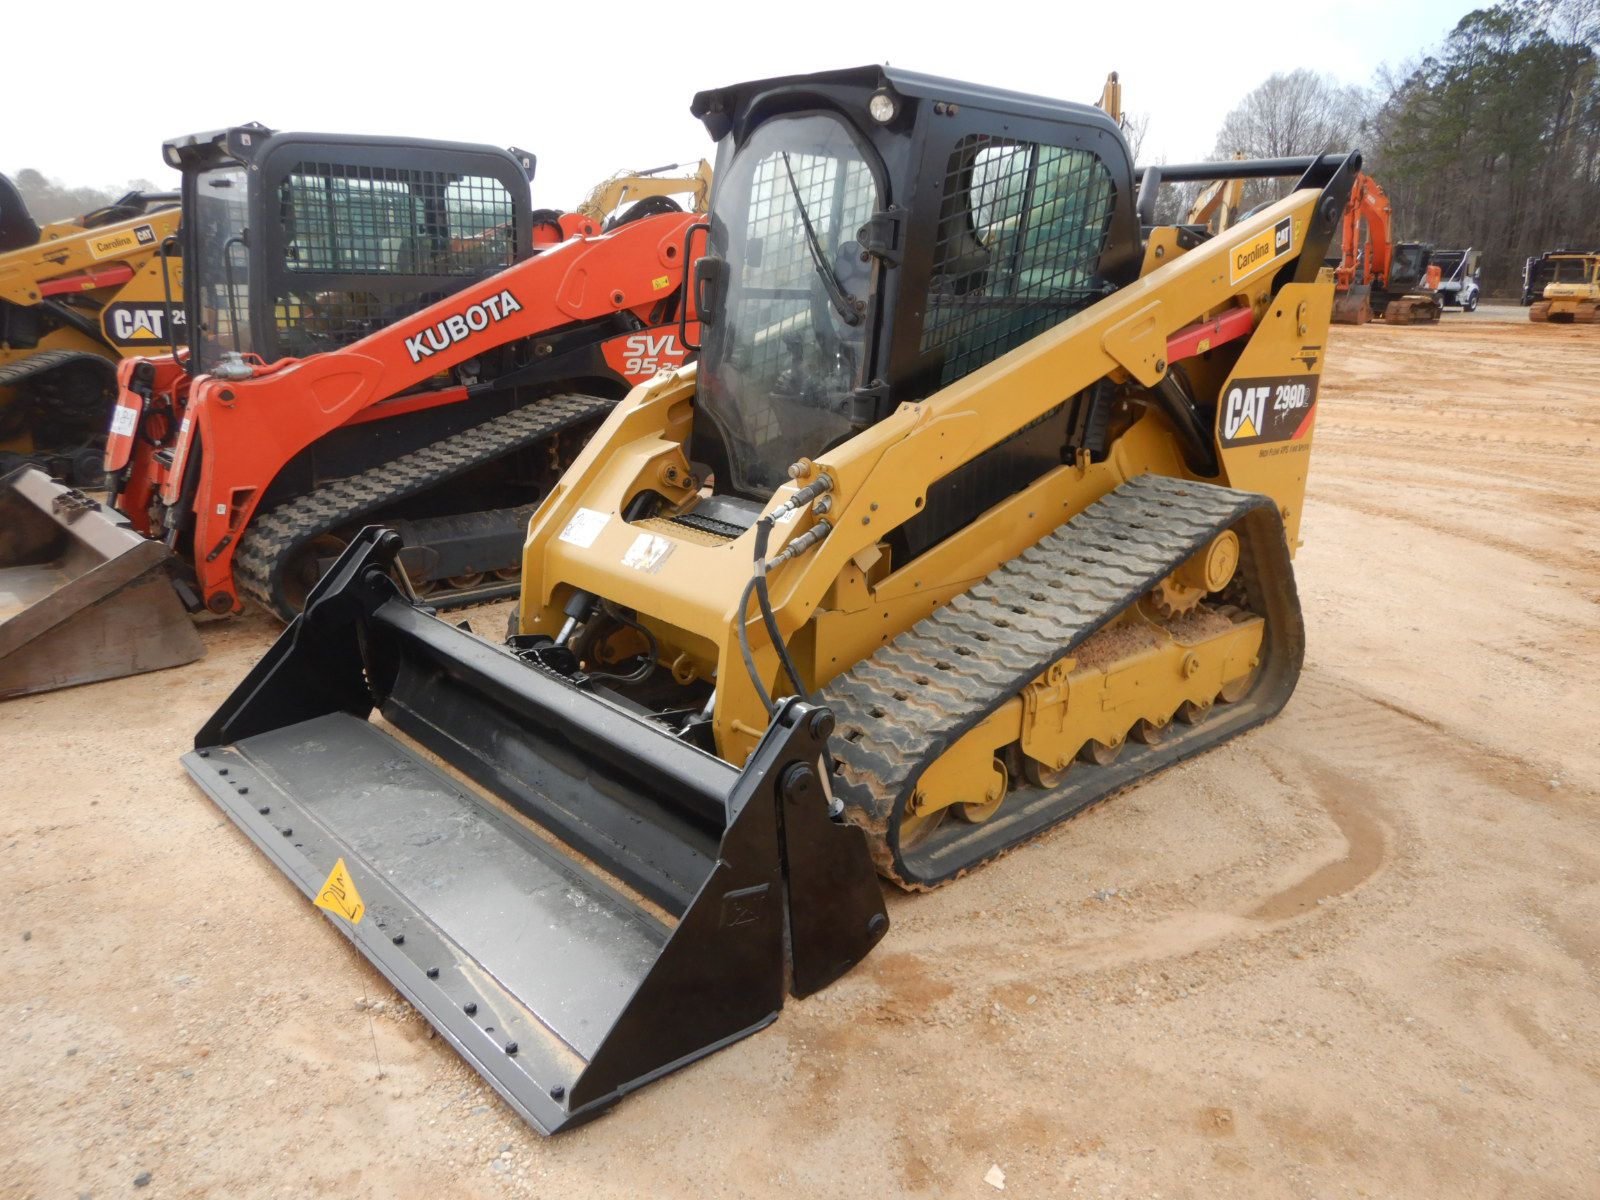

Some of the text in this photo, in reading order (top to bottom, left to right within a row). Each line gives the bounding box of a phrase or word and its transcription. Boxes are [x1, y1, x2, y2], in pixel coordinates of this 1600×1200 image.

[97, 228, 152, 252] Carolina CAT
[1237, 227, 1290, 270] Carolina CAT
[114, 309, 165, 339] CAT
[404, 290, 521, 363] KUBOTA
[623, 335, 684, 357] SVL
[1225, 387, 1271, 440] CAT
